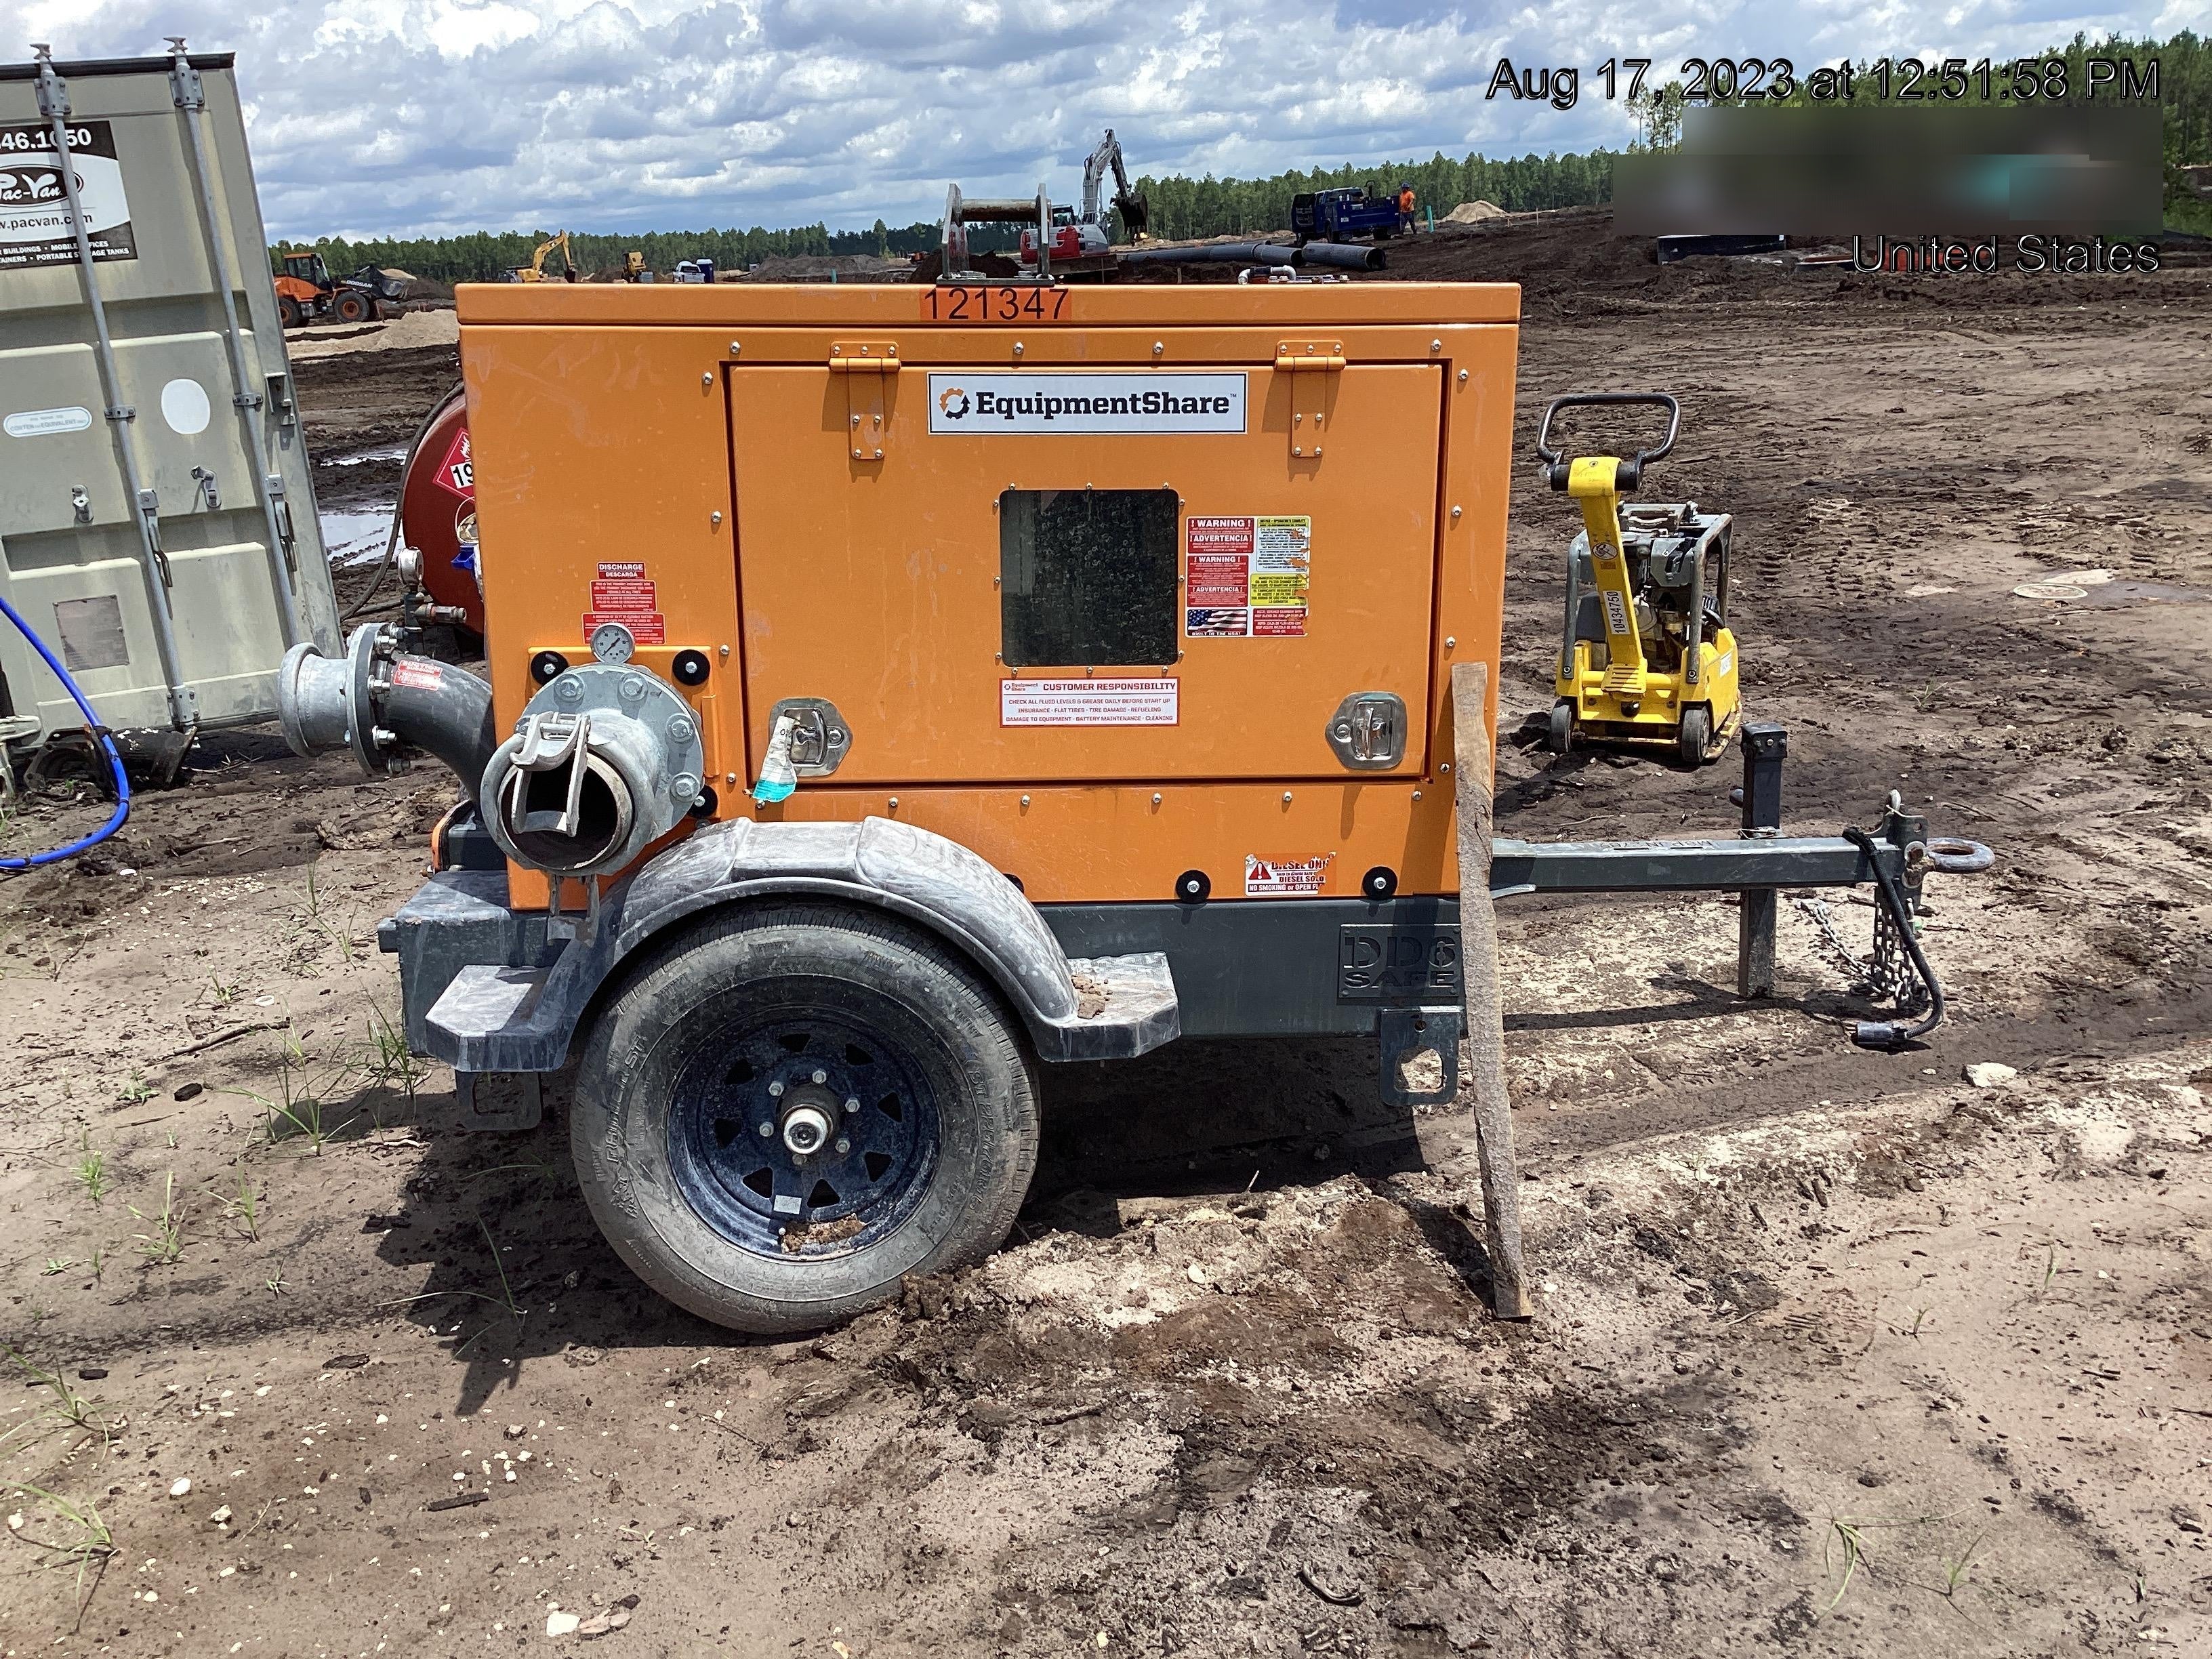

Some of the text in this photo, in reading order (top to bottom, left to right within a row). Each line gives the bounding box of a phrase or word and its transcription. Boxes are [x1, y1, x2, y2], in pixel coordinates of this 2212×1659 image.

[37, 252, 73, 260] PORTABLE
[924, 287, 1069, 320] 121347
[976, 392, 1229, 420] EquipmentShare
[1606, 591, 1626, 634] 10434750
